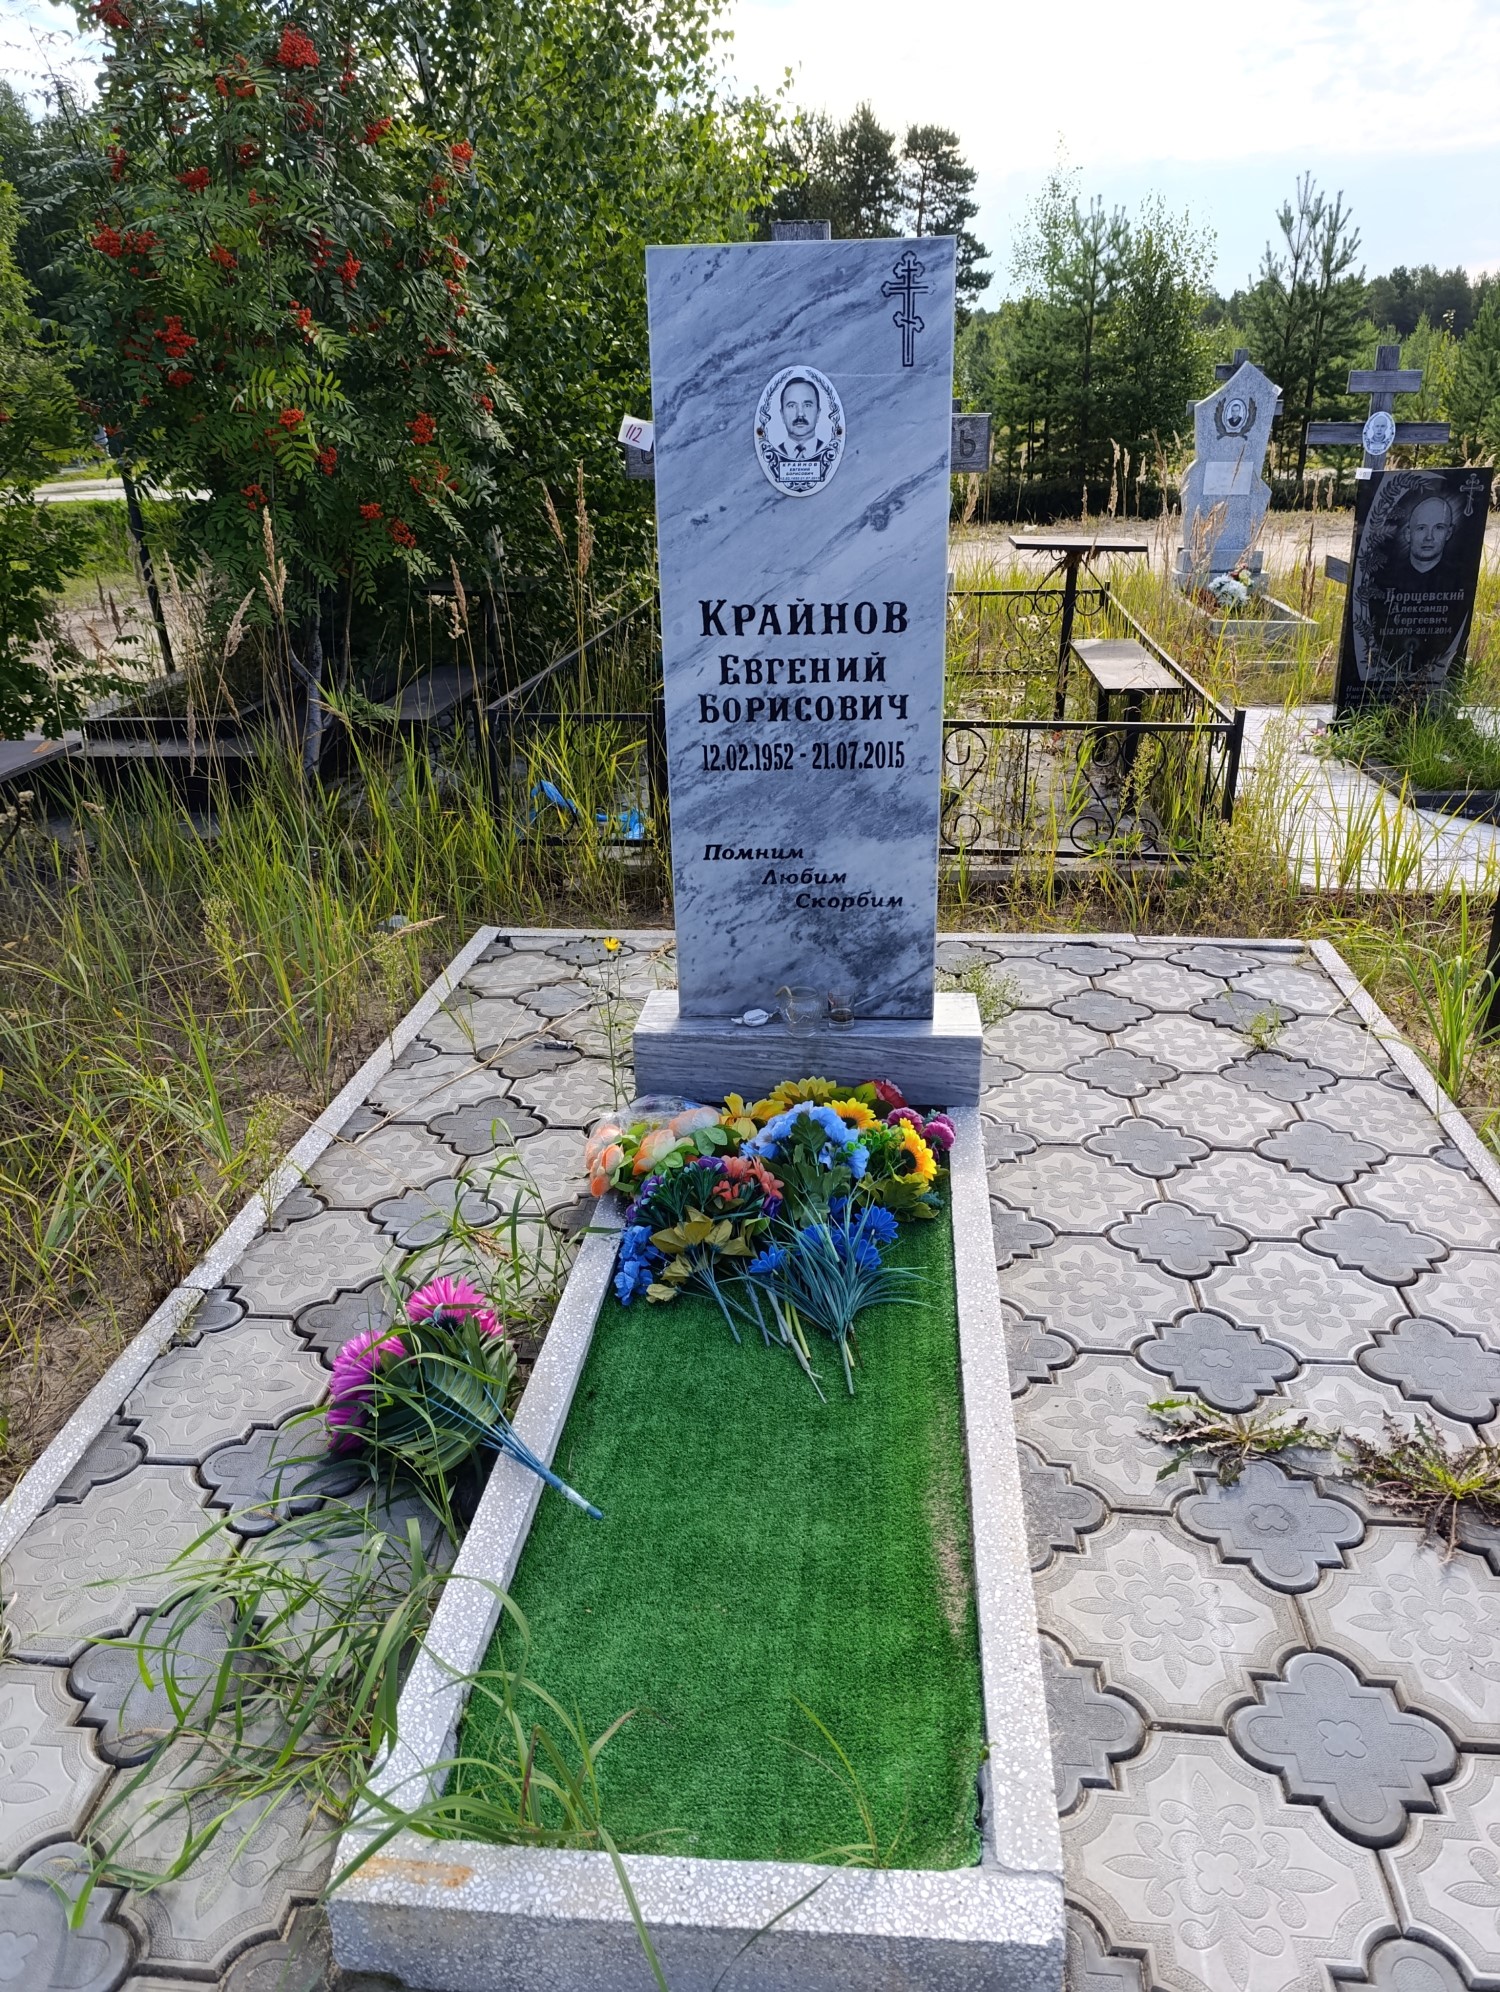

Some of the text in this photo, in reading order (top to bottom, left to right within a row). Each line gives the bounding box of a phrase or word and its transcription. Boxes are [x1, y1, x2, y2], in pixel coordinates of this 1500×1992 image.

[626, 424, 643, 443] 112
[1390, 602, 1449, 615] Александр
[1393, 614, 1448, 627] Сергеевич
[702, 743, 794, 771] 12.02.1952
[812, 741, 905, 770] 21.07.2015
[703, 844, 804, 861] Помним
[762, 868, 847, 885] Любим
[795, 890, 904, 912] Скорбим
